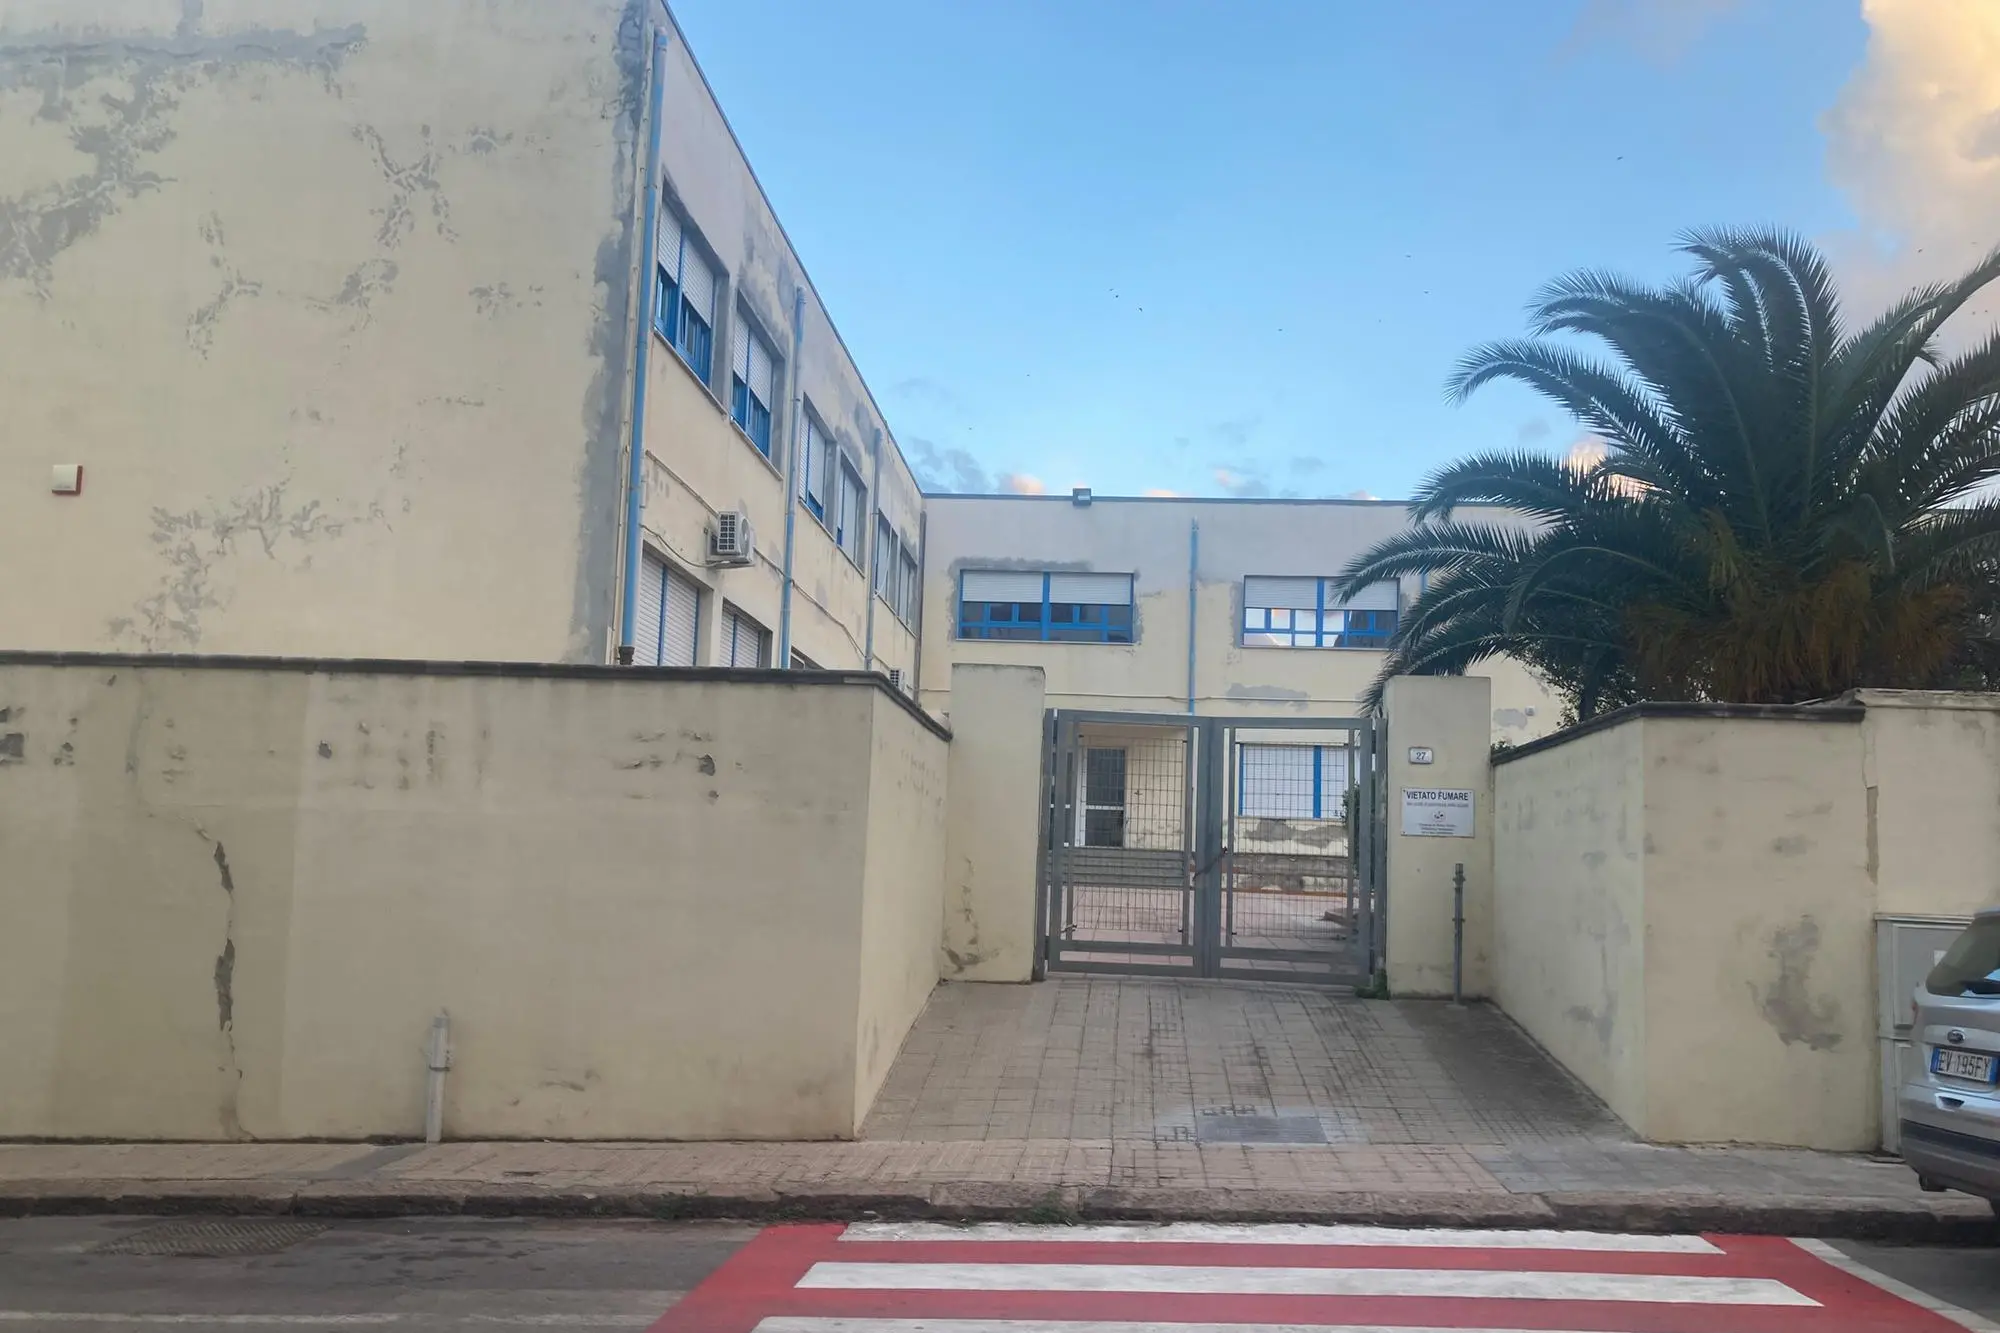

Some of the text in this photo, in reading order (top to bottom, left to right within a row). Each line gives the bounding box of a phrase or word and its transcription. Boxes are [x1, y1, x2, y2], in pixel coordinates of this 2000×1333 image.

[1416, 751, 1426, 760] 27
[1406, 791, 1469, 801] VIETATO FUMARE
[1938, 1051, 1952, 1072] EV
